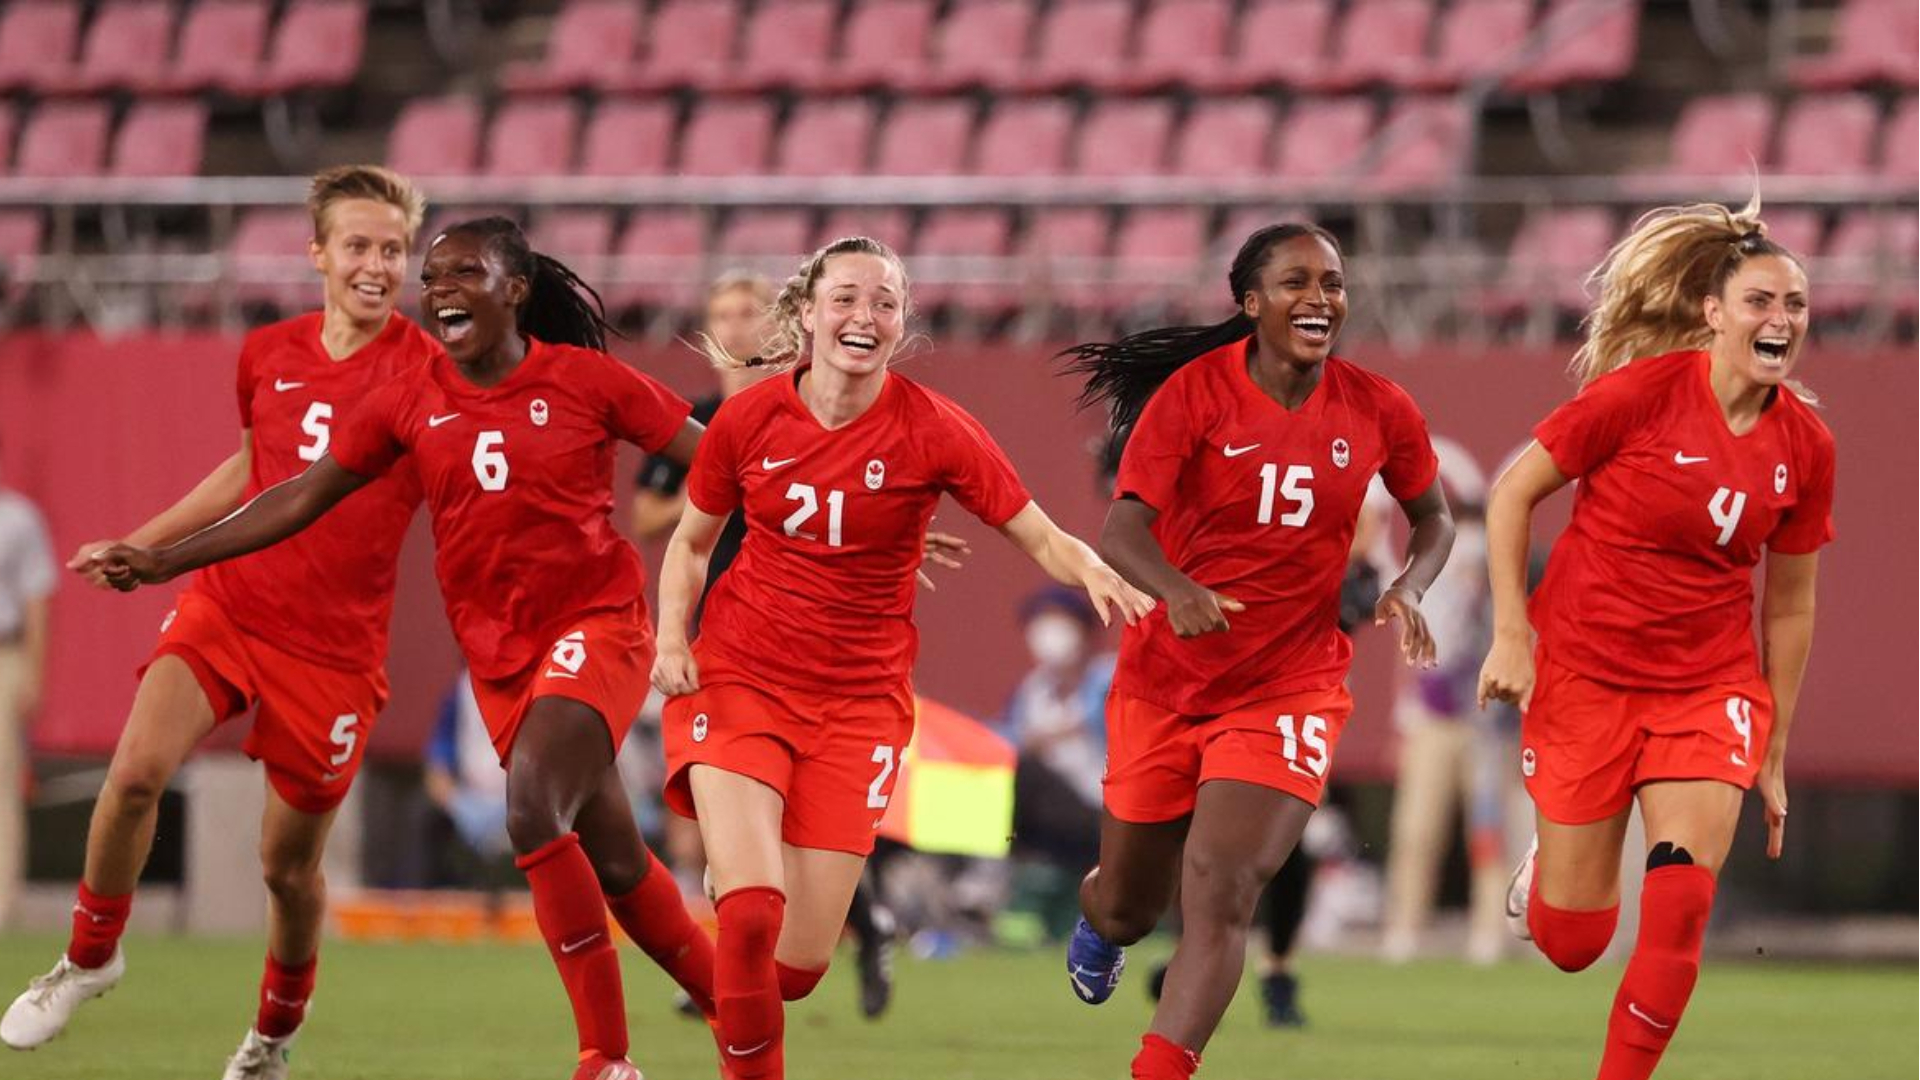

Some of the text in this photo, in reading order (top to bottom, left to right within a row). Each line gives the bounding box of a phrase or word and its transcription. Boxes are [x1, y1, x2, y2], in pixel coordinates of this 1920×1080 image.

[298, 401, 333, 463] 5
[471, 430, 509, 491] 6
[783, 482, 844, 547] 21
[1257, 463, 1314, 527] 15
[1707, 486, 1747, 545] 4
[551, 630, 587, 674] 6
[330, 713, 357, 765] 5
[1276, 714, 1328, 777] 15
[1725, 697, 1751, 758] 4
[867, 745, 908, 808] 2
